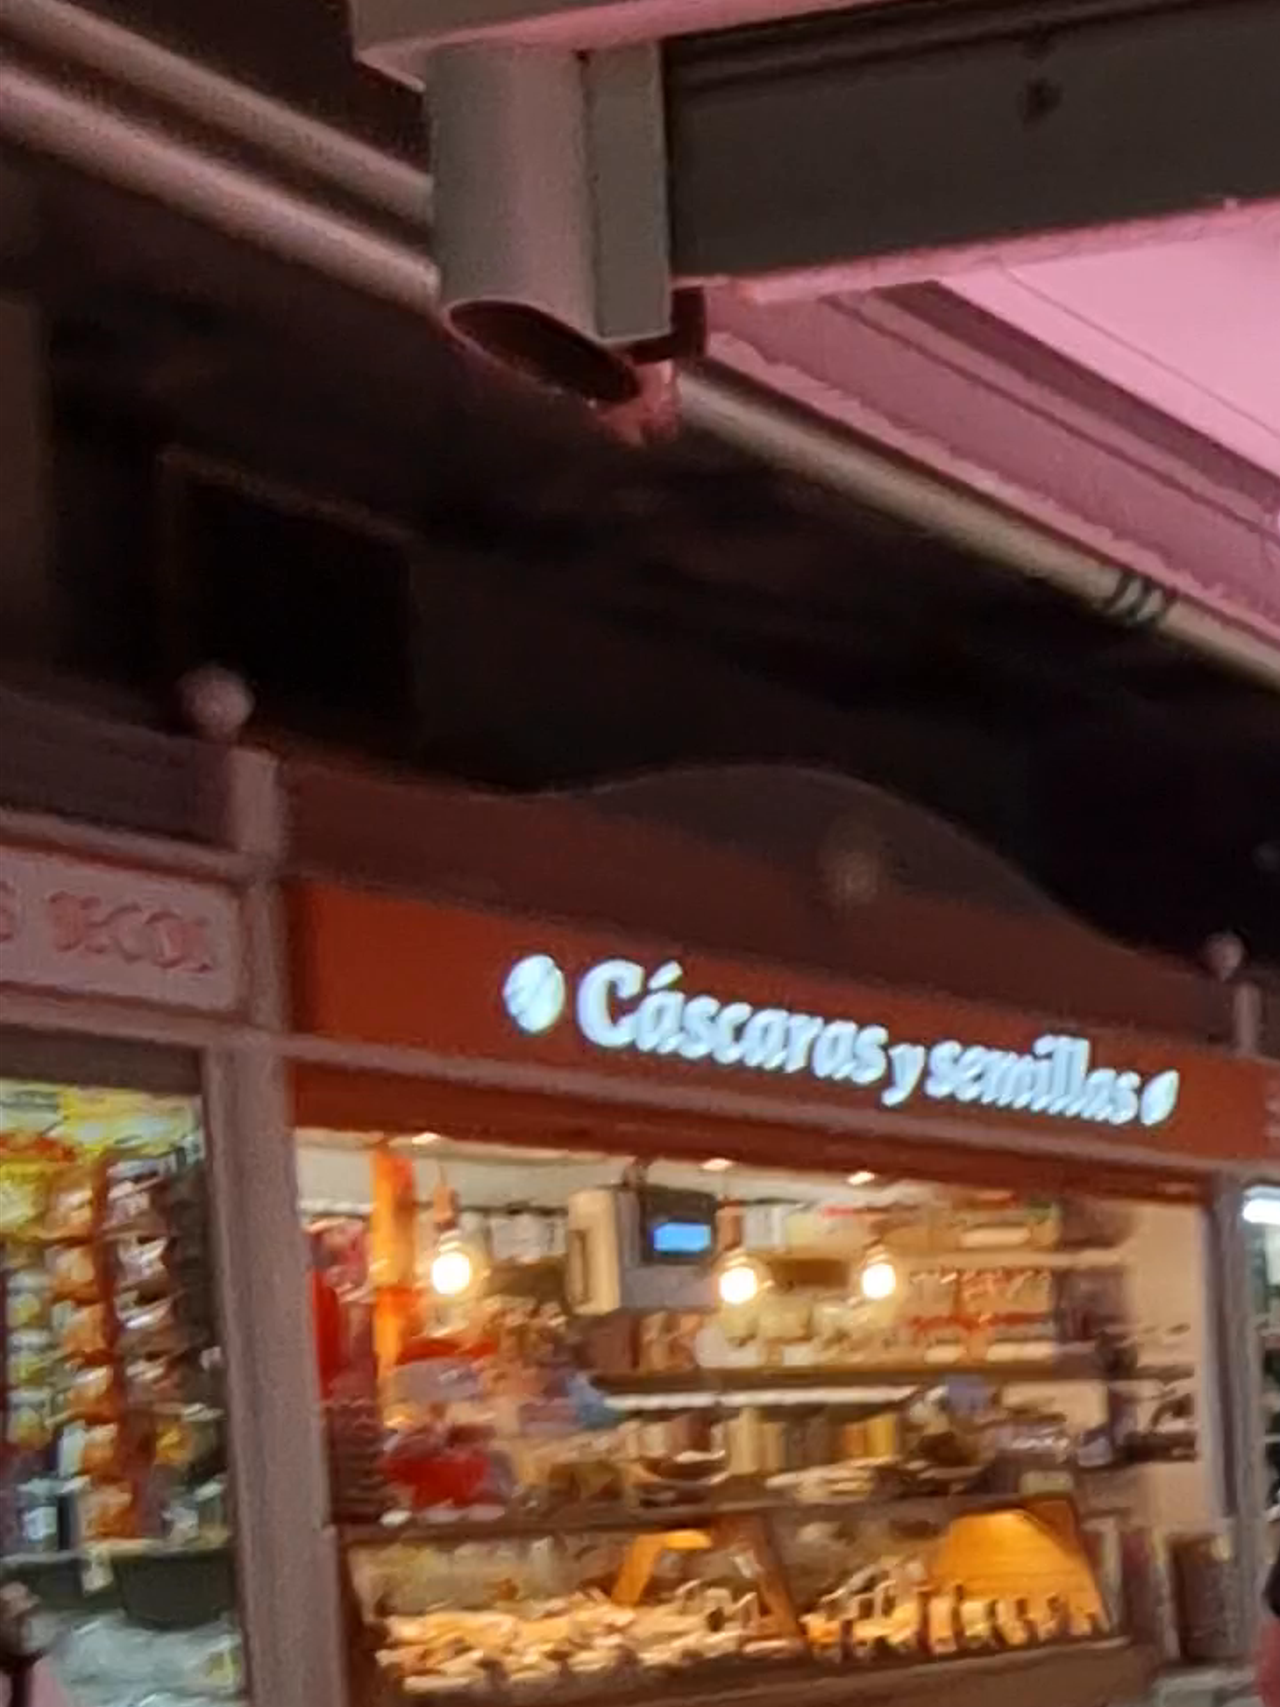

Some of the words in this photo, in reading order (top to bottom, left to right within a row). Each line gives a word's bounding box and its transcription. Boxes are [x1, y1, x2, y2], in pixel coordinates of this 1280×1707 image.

[576, 959, 888, 1085] Cáscaras
[880, 1042, 926, 1107] y
[926, 1034, 1141, 1126] semillas
